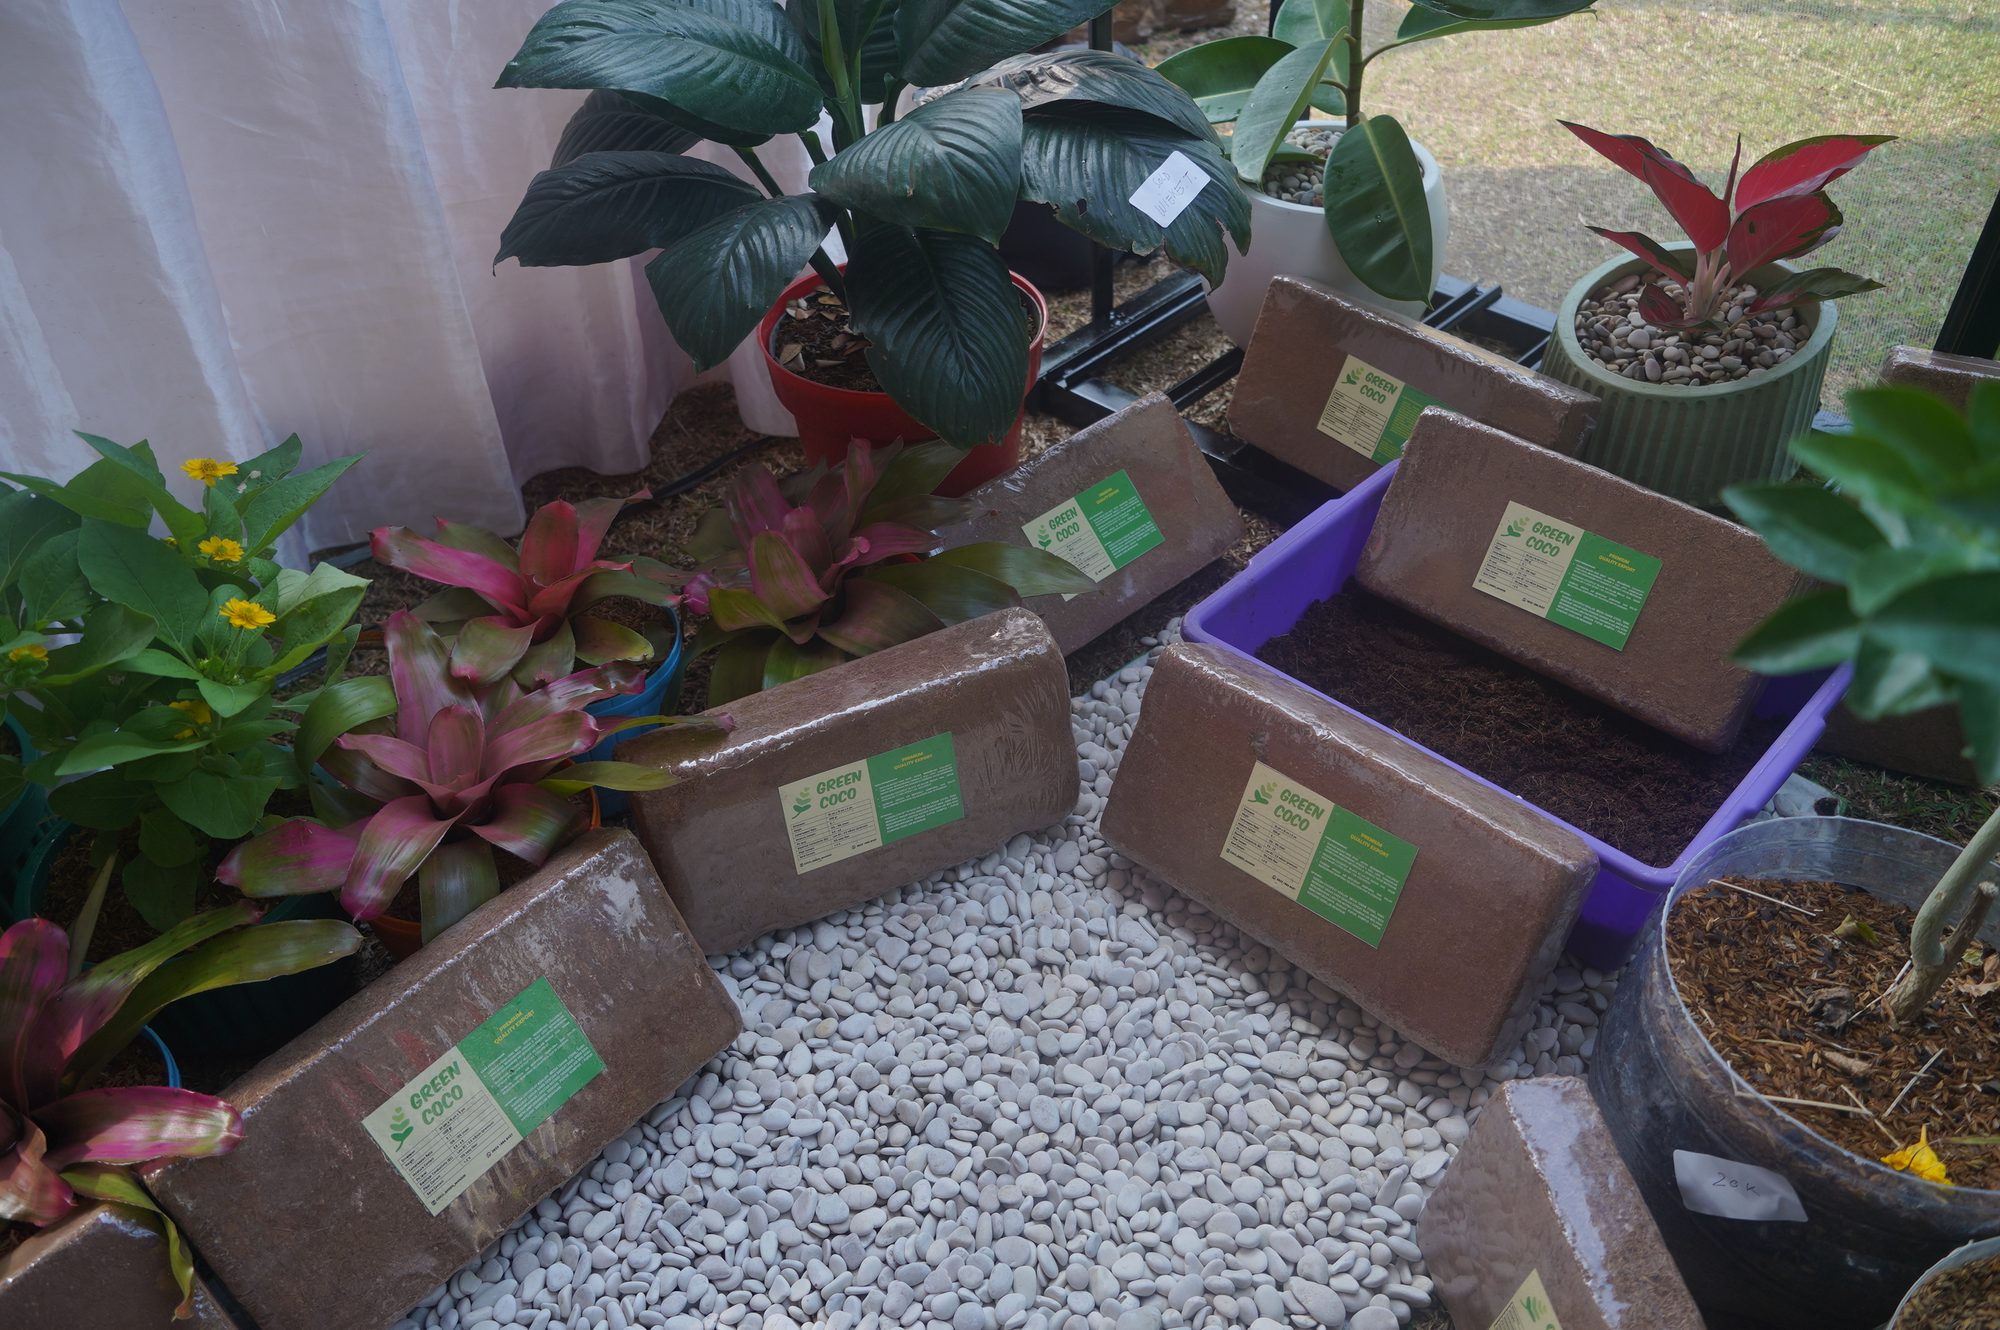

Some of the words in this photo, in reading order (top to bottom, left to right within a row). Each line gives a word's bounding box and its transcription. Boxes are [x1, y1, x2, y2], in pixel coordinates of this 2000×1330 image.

[1360, 385, 1386, 404] COCO
[1365, 372, 1398, 394] GREEN
[1048, 507, 1078, 530] GREEN
[1056, 522, 1080, 542] COCO
[1532, 521, 1575, 546] GREEN
[1526, 536, 1560, 558] COCO
[816, 769, 863, 795] GREEN
[819, 787, 857, 809] COCO
[1279, 788, 1324, 821] GREEN
[1273, 804, 1310, 832] COCO
[410, 1060, 462, 1109] GREEN
[421, 1084, 464, 1126] COCO
